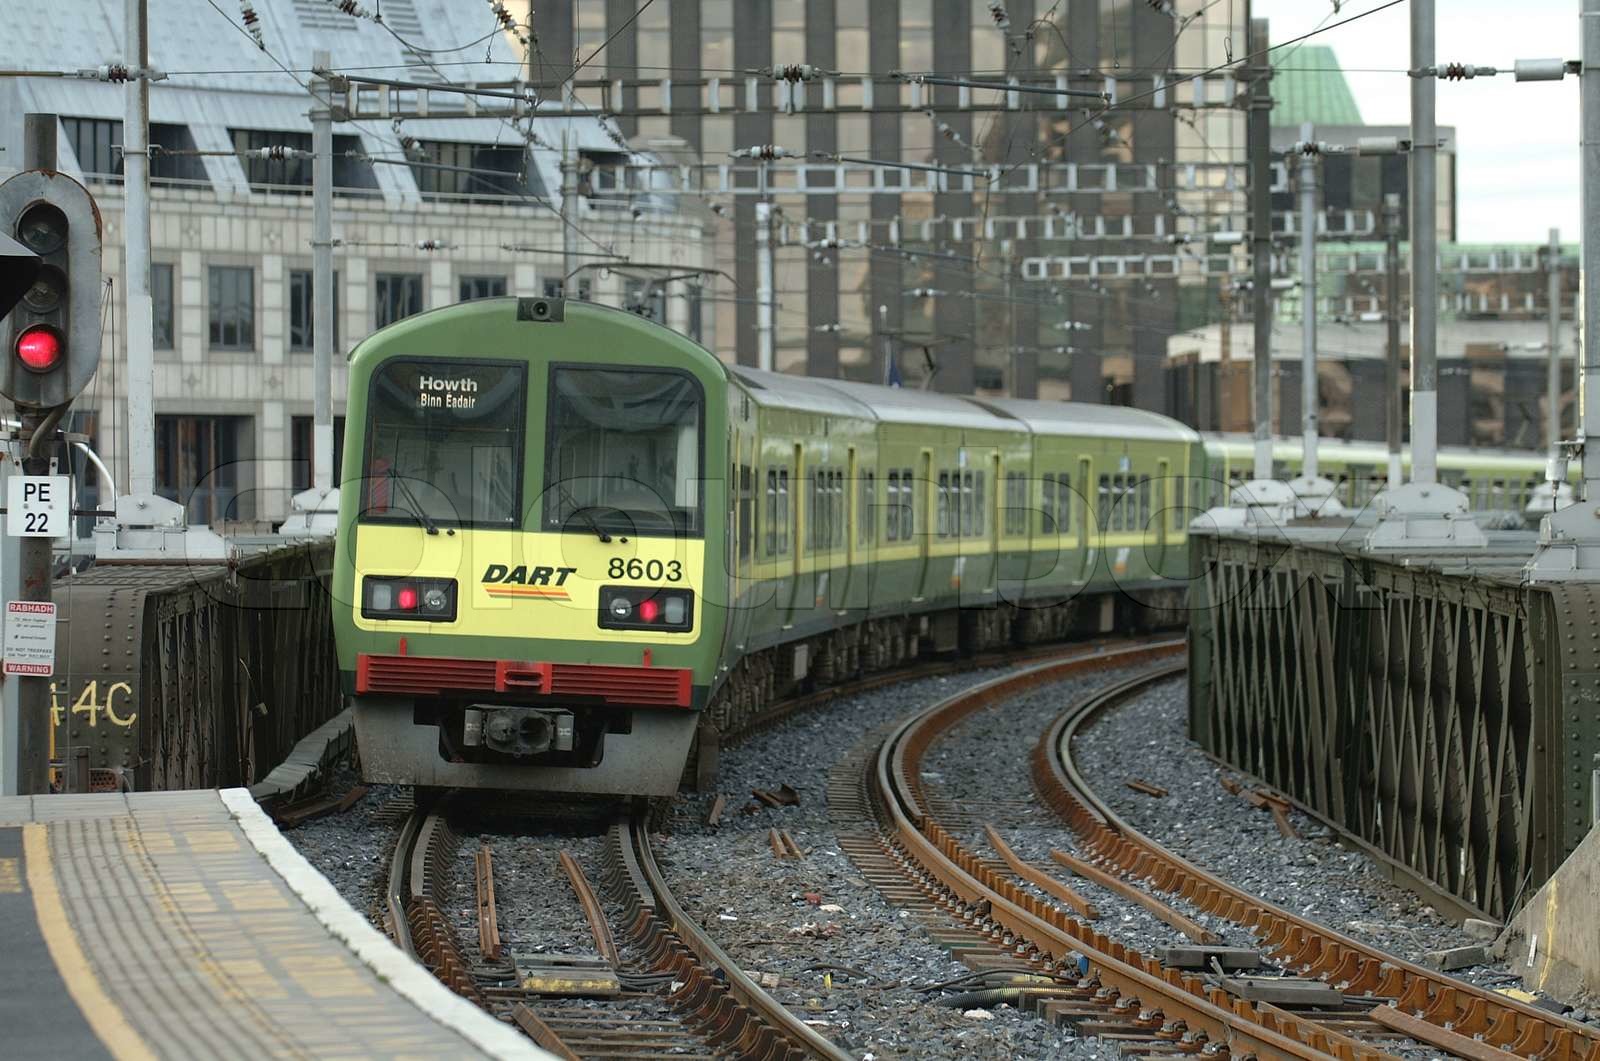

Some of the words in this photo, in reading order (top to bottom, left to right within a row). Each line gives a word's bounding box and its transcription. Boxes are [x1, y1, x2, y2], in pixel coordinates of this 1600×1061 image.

[420, 375, 478, 392] Howth
[420, 392, 442, 407] Binn
[24, 483, 51, 502] PE
[24, 512, 49, 533] 22
[481, 564, 577, 586] DART
[608, 557, 682, 581] 8603
[9, 603, 53, 615] RABHADH
[7, 664, 49, 674] WARNING
